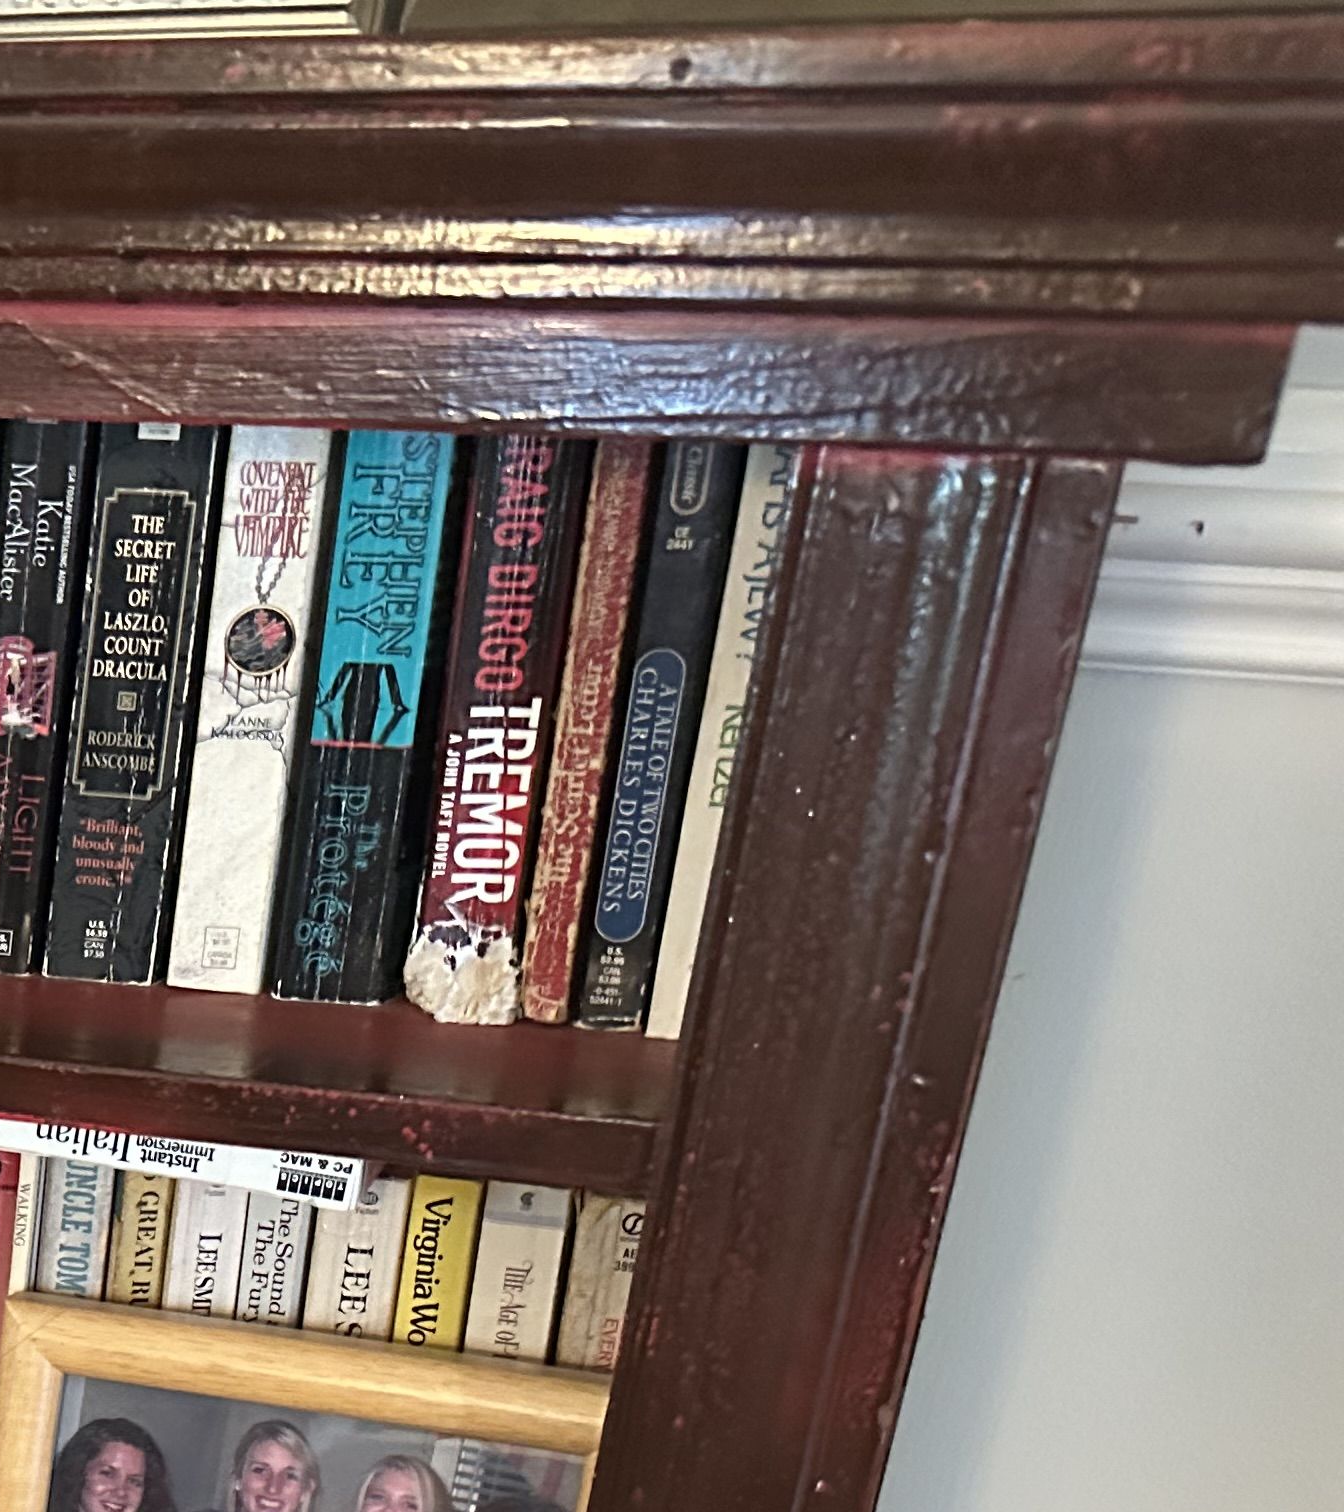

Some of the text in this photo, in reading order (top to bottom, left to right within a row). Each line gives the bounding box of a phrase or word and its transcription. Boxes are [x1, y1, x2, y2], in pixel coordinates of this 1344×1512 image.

[0, 463, 37, 602] MacAlister
[32, 498, 64, 569] Katie
[132, 516, 164, 535] THE
[114, 539, 176, 560] SECRET
[126, 564, 159, 583] LIFE
[128, 589, 151, 607] OF
[104, 637, 164, 656] COUNT
[93, 660, 168, 681] DRACULA
[87, 730, 156, 749] RODERICK
[82, 752, 155, 772] ANSCOMBE
[602, 668, 659, 912] CHARLES DICKENS
[450, 697, 542, 906] TREMOR
[432, 750, 459, 879] JOHN TAFT NOVEL
[136, 1135, 214, 1161] Immersion
[138, 1148, 199, 1174] Instant
